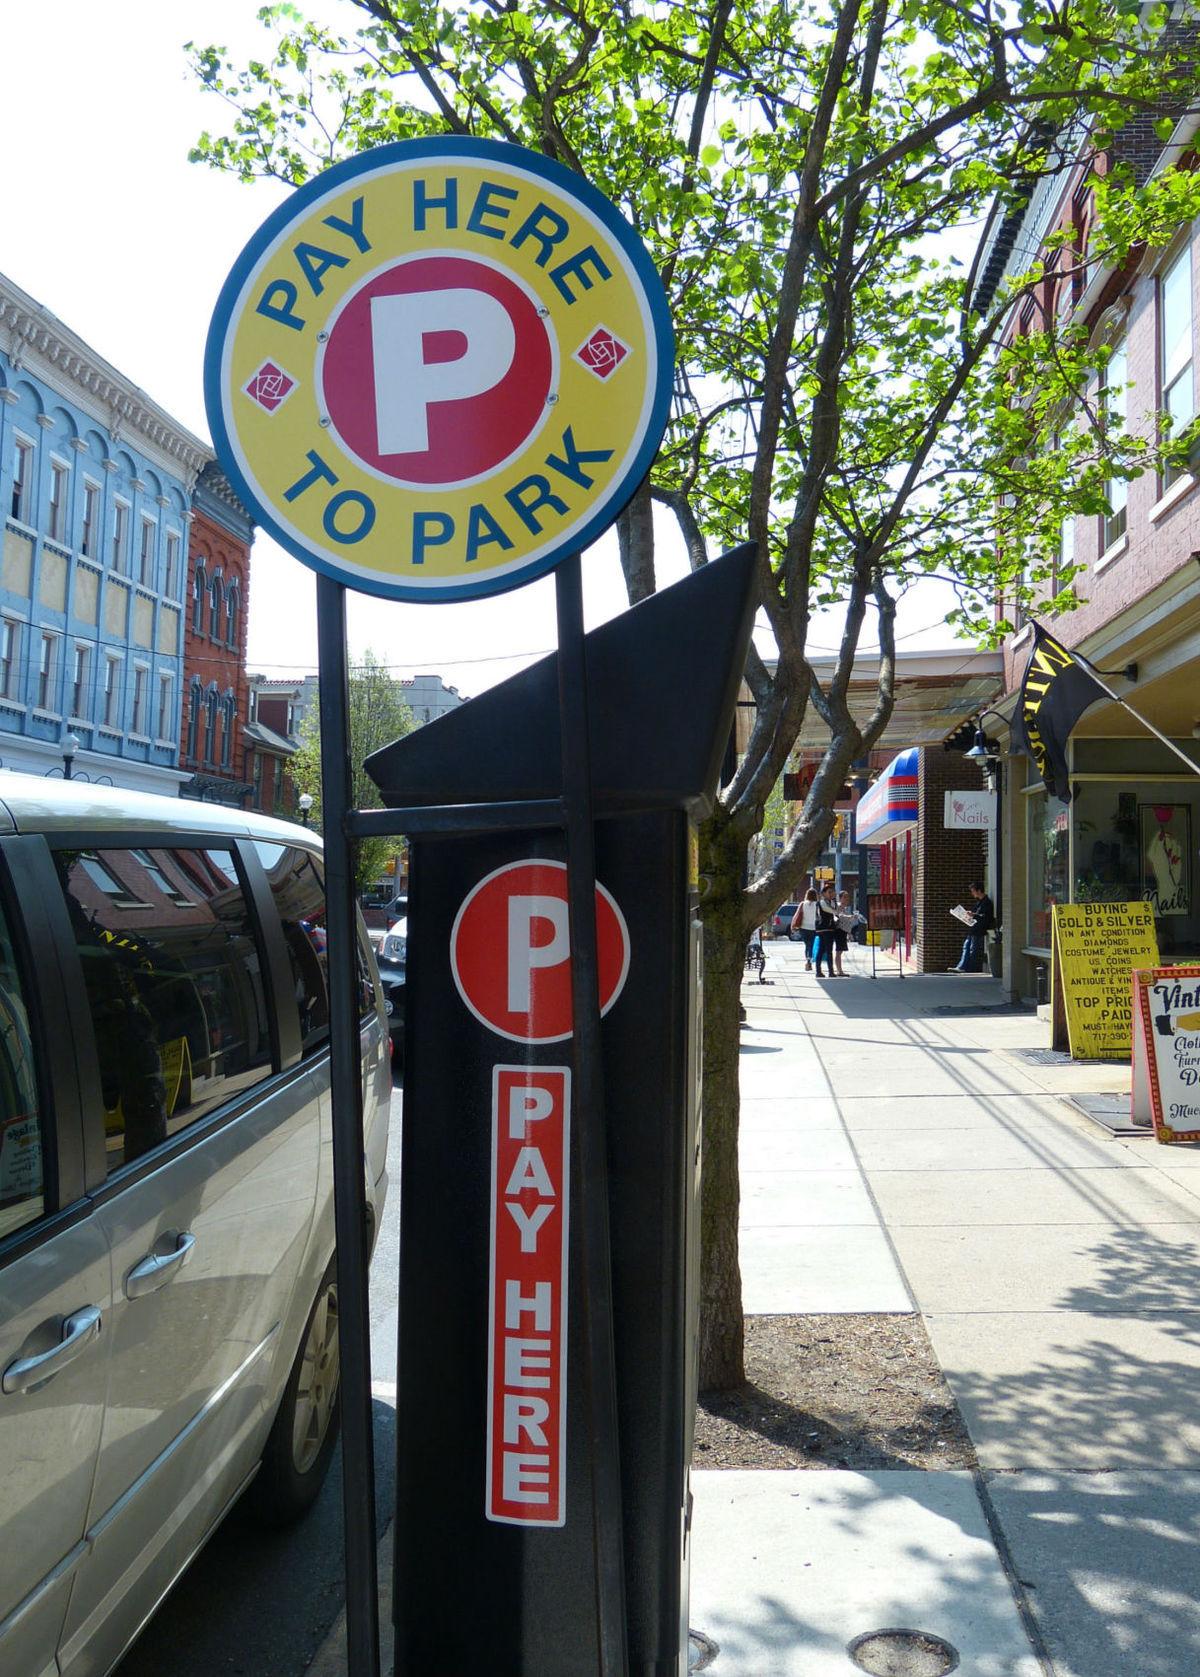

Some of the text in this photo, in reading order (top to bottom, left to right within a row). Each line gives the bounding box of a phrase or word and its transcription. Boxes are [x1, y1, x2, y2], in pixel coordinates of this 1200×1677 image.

[256, 177, 612, 332] PAY HERE
[370, 288, 516, 455] P
[282, 425, 615, 564] TO PARK
[954, 810, 989, 823] Nails
[1085, 904, 1128, 915] BUYING
[1059, 915, 1152, 928] GOLD & SILVER
[1101, 928, 1145, 936] CONDITION
[1084, 938, 1129, 946] DIAMONDS
[508, 895, 570, 1013] P
[1065, 947, 1151, 956] COSTUME JEWELRY
[1092, 967, 1133, 975] WATCHES
[1071, 977, 1106, 985] ANTIQUE
[1075, 996, 1133, 1008] TOP PRIC
[1154, 979, 1200, 1014] Vint
[1101, 1010, 1132, 1020] PAID
[1083, 1022, 1106, 1030] MUST
[502, 1086, 556, 1504] PAY HERE
